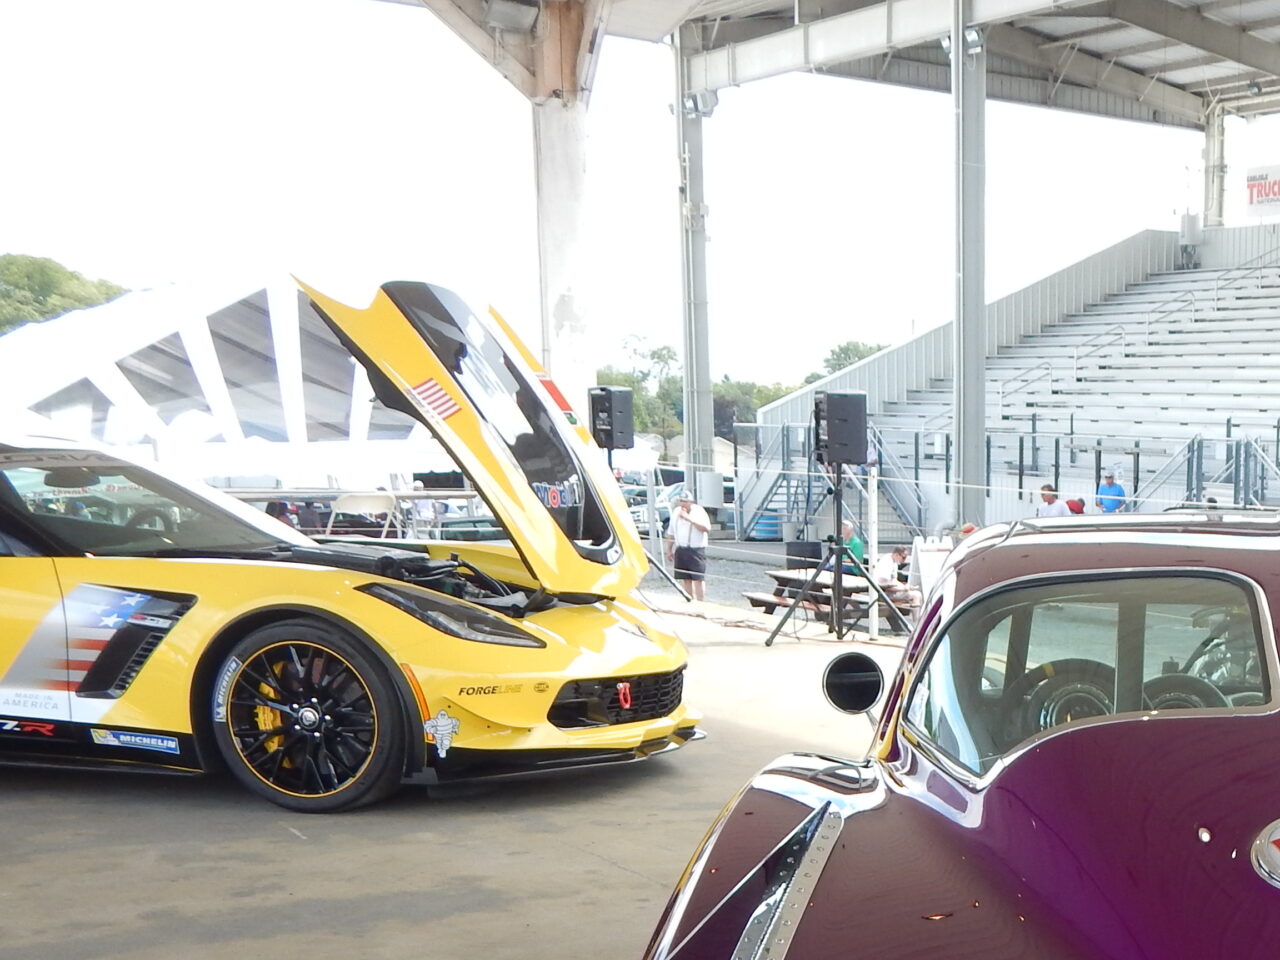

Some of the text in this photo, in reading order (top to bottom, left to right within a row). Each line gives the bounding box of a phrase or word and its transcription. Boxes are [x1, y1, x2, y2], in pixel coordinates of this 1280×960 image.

[458, 684, 523, 696] FORGELINE
[15, 692, 39, 700] MADE
[3, 699, 59, 710] AMERICA
[119, 735, 176, 748] MICHELIN
